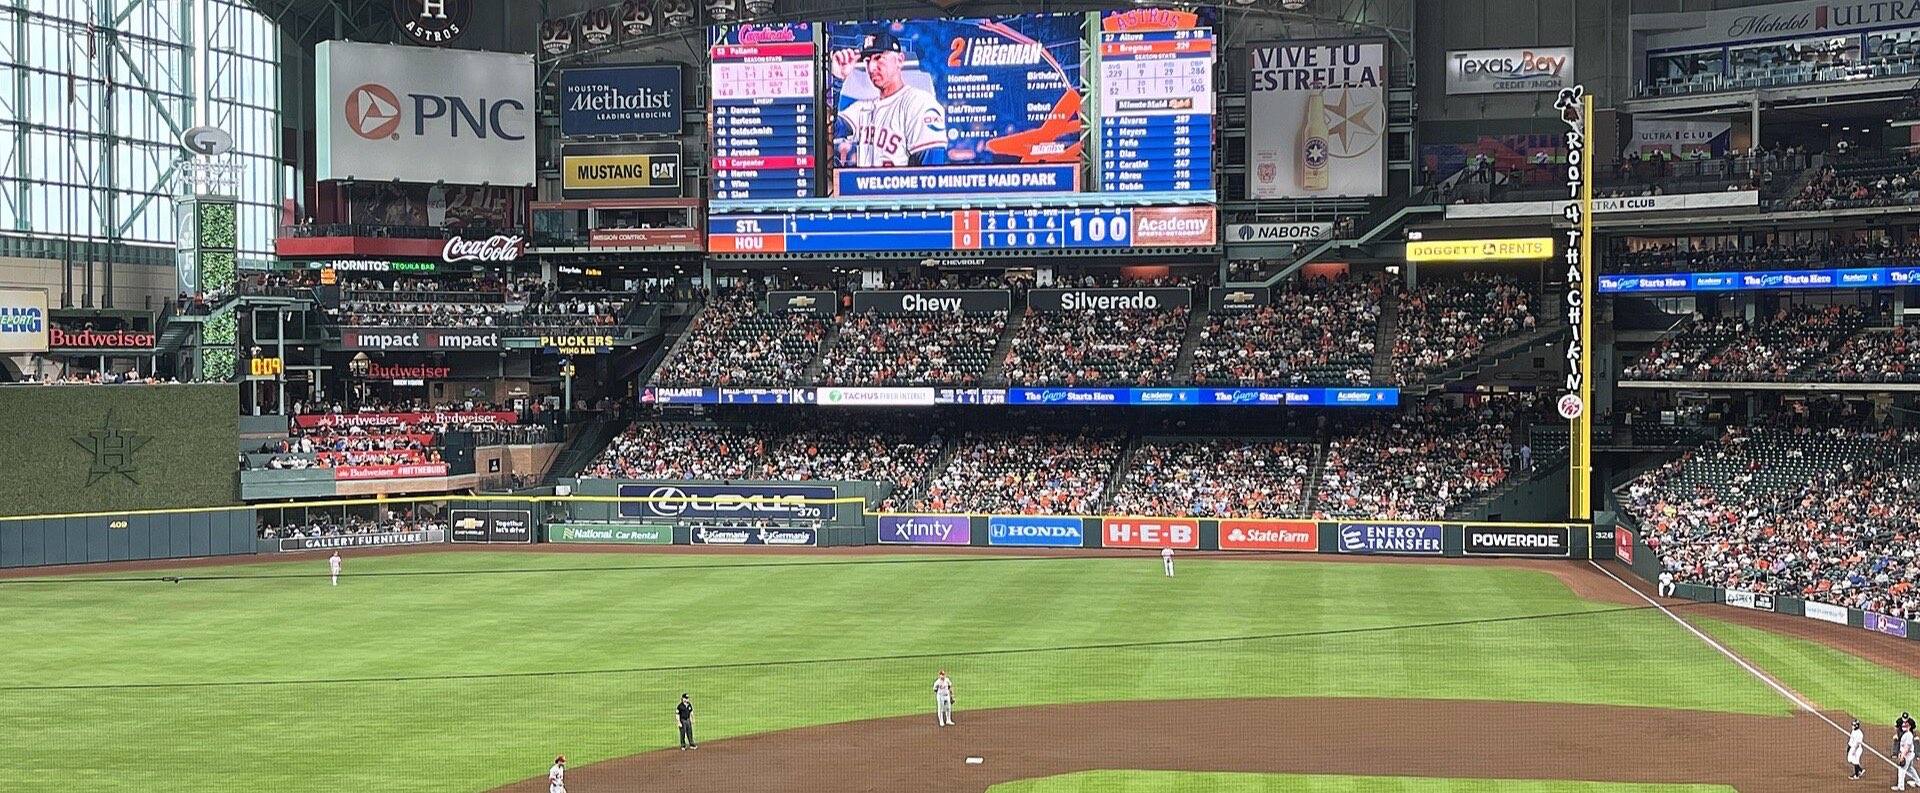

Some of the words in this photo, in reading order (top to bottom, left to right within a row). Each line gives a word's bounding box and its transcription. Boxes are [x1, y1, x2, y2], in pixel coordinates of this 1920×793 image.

[420, 0, 447, 19] H
[582, 8, 609, 31] 40
[1117, 8, 1180, 30] ASTROS
[1728, 13, 1810, 37] Michelob
[406, 20, 460, 41] ASTROS
[541, 18, 569, 41] 32
[1120, 33, 1144, 41] Altuve
[948, 37, 966, 67] 2
[971, 43, 1042, 66] BREGMAN
[1120, 45, 1152, 54] Bregman
[1322, 44, 1361, 66] TU
[1189, 67, 1205, 75] .286
[1454, 52, 1513, 75] Texas
[1522, 51, 1566, 77] Bay
[1251, 65, 1384, 92] ESTRELLA!
[1493, 80, 1526, 89] CREDIT
[1529, 80, 1562, 89] UNION
[568, 85, 609, 93] HOUSTON
[569, 88, 672, 111] Methodist
[1027, 103, 1051, 112] Debut
[407, 93, 526, 140] PNC
[1642, 132, 1672, 140] ULTRA
[578, 164, 642, 180] MUSTANG
[652, 163, 676, 178] CAT
[1566, 131, 1582, 198] ROOT
[856, 176, 918, 190] WELCOME
[920, 175, 936, 189] TO
[938, 175, 987, 187] MINUTE
[988, 174, 1021, 186] MAID
[1023, 173, 1056, 185] PARK
[1627, 199, 1655, 208] CLUB
[1565, 203, 1580, 224] 4
[736, 220, 762, 233] STL
[791, 221, 796, 232] 1
[963, 218, 970, 230] 1
[988, 218, 996, 230] 2
[1008, 217, 1016, 229] 0
[1028, 217, 1034, 229] 1
[1046, 217, 1056, 228] 4
[1070, 218, 1082, 241] 1
[1089, 217, 1105, 241] 0
[1110, 216, 1126, 241] 0
[1138, 217, 1209, 233] Academy
[963, 234, 971, 246] 0
[988, 233, 995, 246] 1
[1008, 233, 1016, 245] 0
[1027, 233, 1036, 245] 0
[1046, 232, 1056, 244] 4
[1258, 225, 1320, 239] NABORS
[442, 235, 524, 263] Coca-Cola
[735, 237, 763, 249] HOU
[1414, 246, 1478, 256] DOGGETT
[1500, 243, 1543, 254] RENTS
[1565, 230, 1581, 283] THA
[332, 260, 390, 271] HORNITOS
[1601, 279, 1617, 288] The
[1640, 279, 1664, 287] Starts
[1665, 279, 1687, 287] Here
[1744, 276, 1760, 285] The
[1783, 274, 1809, 284] Starts
[1810, 274, 1831, 284] Here
[1891, 272, 1908, 281] The
[902, 294, 962, 312] Chevy
[1061, 291, 1157, 310] Silverado
[2, 307, 41, 332] LNG
[50, 330, 154, 347] Budweiser
[358, 332, 419, 350] impact
[439, 332, 498, 349] impact
[540, 335, 614, 347] PLUCKERS
[1566, 289, 1581, 390] CHIKIN
[251, 357, 281, 376] 0:09
[368, 362, 451, 378] Budweiser
[659, 388, 703, 397] PALLANTE
[844, 392, 879, 400] TACHUS
[1025, 392, 1041, 401] The
[1067, 392, 1092, 401] Starts
[1093, 392, 1114, 401] Here
[1215, 392, 1232, 401] The
[1286, 392, 1309, 401] Here
[334, 414, 399, 427] Budweiser
[435, 413, 497, 424] Budweiser
[350, 467, 395, 476] Budweiser
[691, 494, 805, 511] LEXUS
[797, 508, 821, 517] 370
[109, 520, 128, 529] 409
[895, 522, 953, 541] xfinity
[1007, 525, 1082, 538] HONDA
[574, 529, 612, 539] National
[631, 531, 659, 539] Rental
[1109, 523, 1192, 543] H-E-B
[1367, 526, 1426, 539] ENERGY
[1595, 531, 1614, 539] 326
[305, 535, 355, 548] GALLERY
[358, 533, 422, 546] FURNITURE
[1368, 538, 1440, 551] TRANSFER
[1472, 533, 1560, 548] POWERADE
